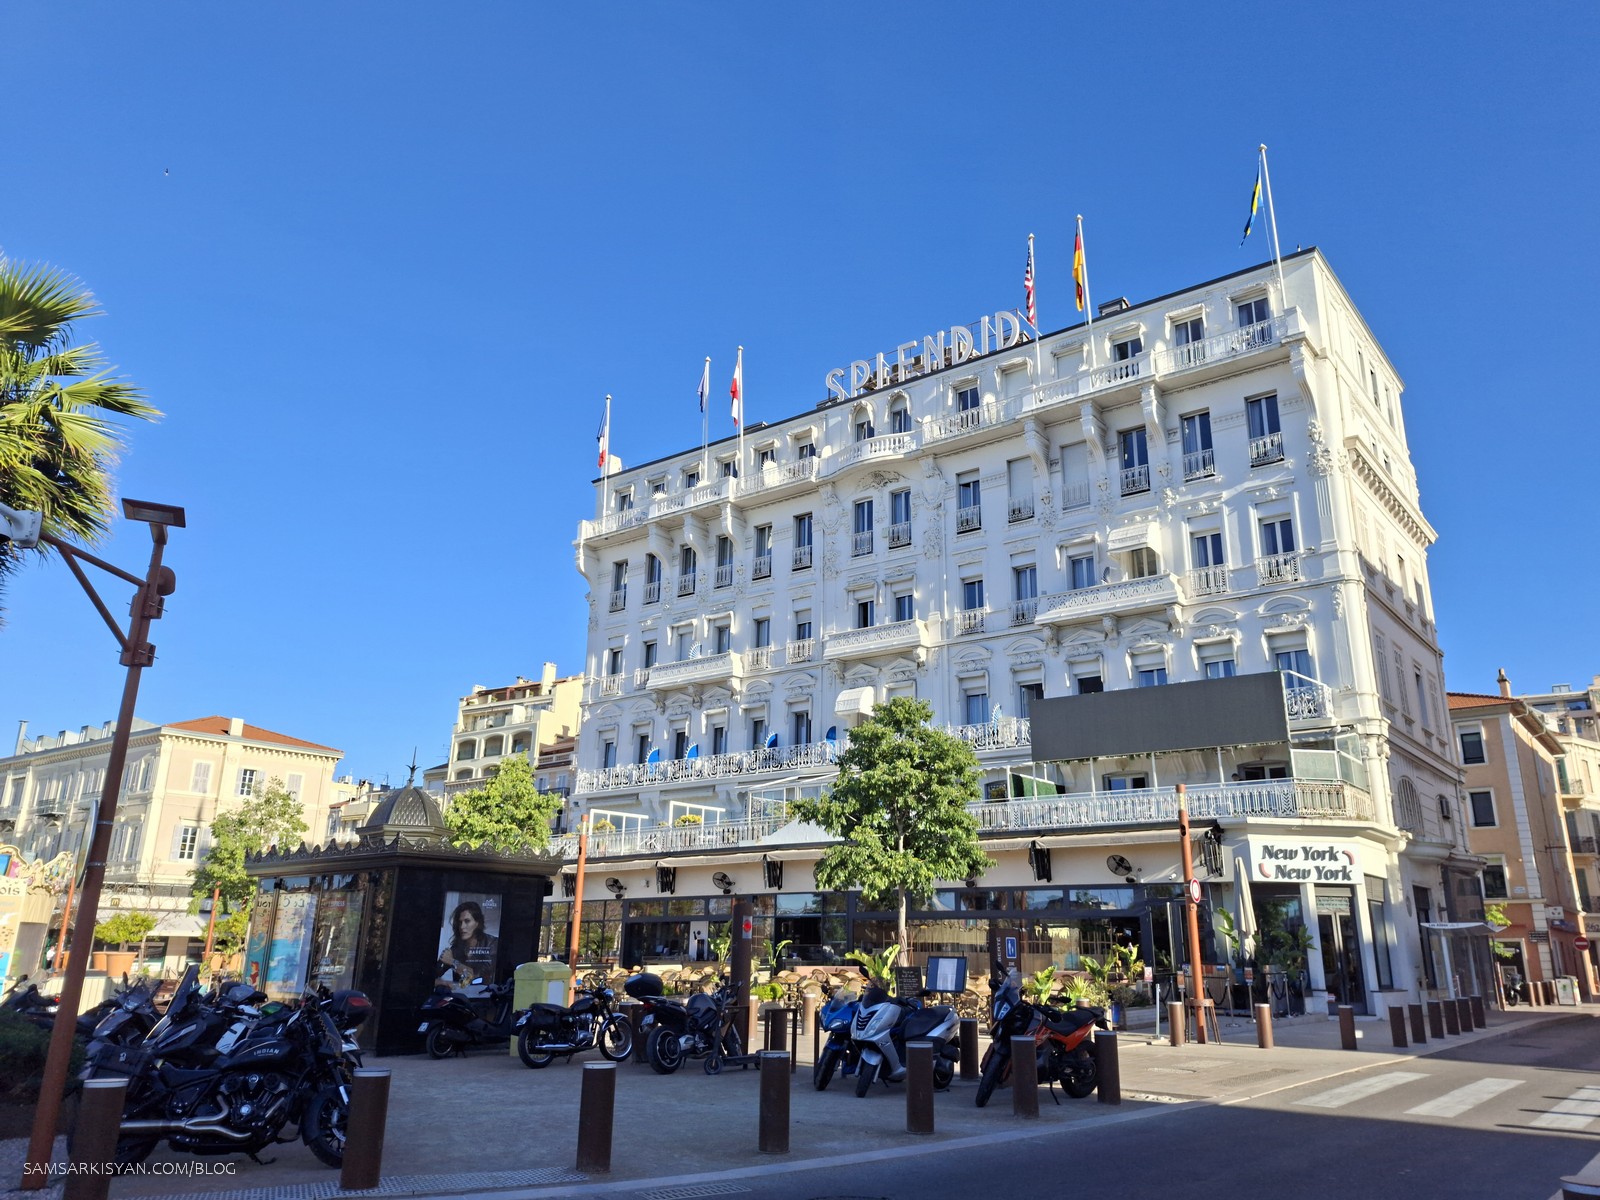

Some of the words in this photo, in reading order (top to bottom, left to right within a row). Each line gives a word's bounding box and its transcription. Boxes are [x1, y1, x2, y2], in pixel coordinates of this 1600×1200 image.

[826, 311, 1020, 402] SPLENDID
[1261, 844, 1299, 861] New
[1301, 845, 1340, 862] York
[1274, 864, 1312, 880] New
[1313, 865, 1353, 881] York
[253, 1048, 280, 1056] INDIAN
